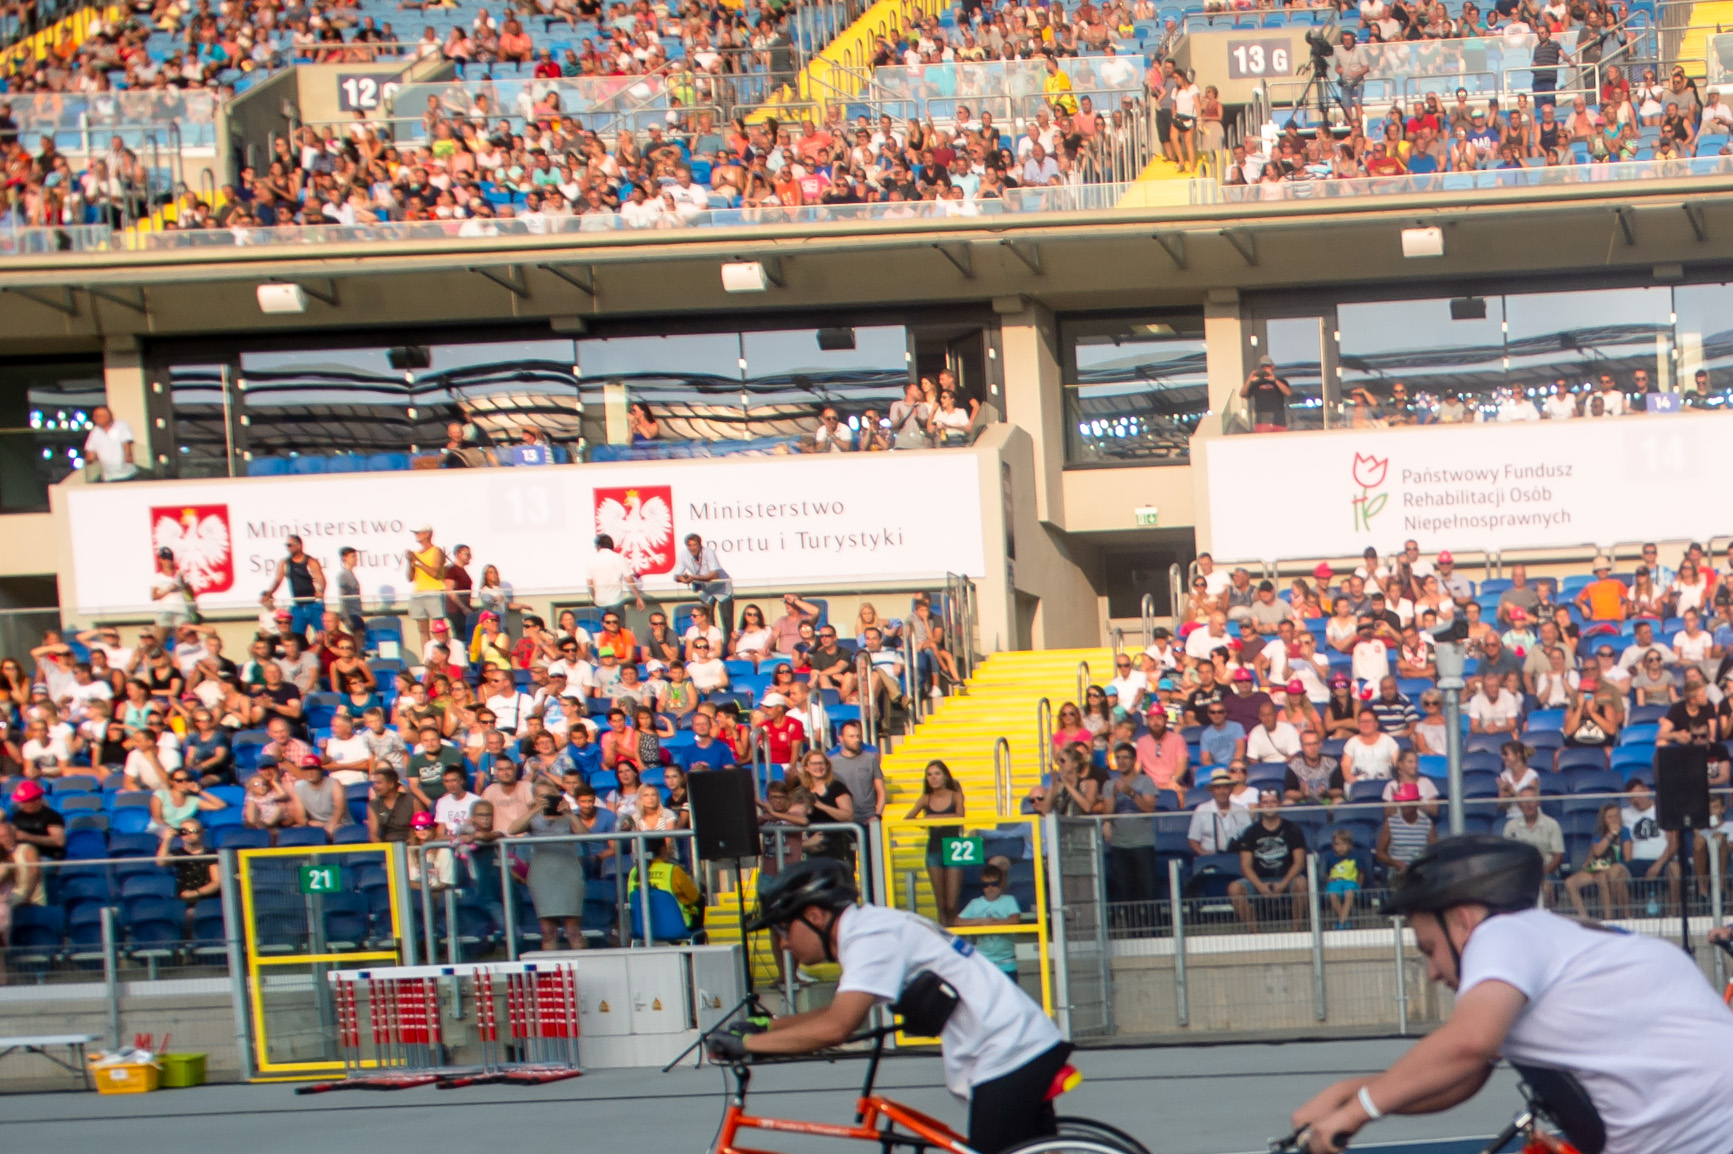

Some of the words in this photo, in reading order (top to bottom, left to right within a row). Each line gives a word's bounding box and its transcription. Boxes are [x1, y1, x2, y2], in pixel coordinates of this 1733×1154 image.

[1233, 45, 1265, 74] 13
[1272, 48, 1288, 73] G
[342, 78, 377, 107] 12
[1402, 467, 1500, 485] Państwowy
[1504, 462, 1574, 480] Fundusz
[1403, 487, 1506, 508] Rehabilitacji
[1510, 485, 1553, 503] Osób
[689, 500, 846, 521] Ministerstwo
[1404, 508, 1572, 533] Niepełnosprawnych
[247, 518, 404, 539] Ministerstwo
[706, 535, 769, 554] portu
[779, 532, 785, 550] i
[795, 527, 905, 552] Turystyki
[950, 840, 974, 861] 22
[309, 870, 332, 889] 21
